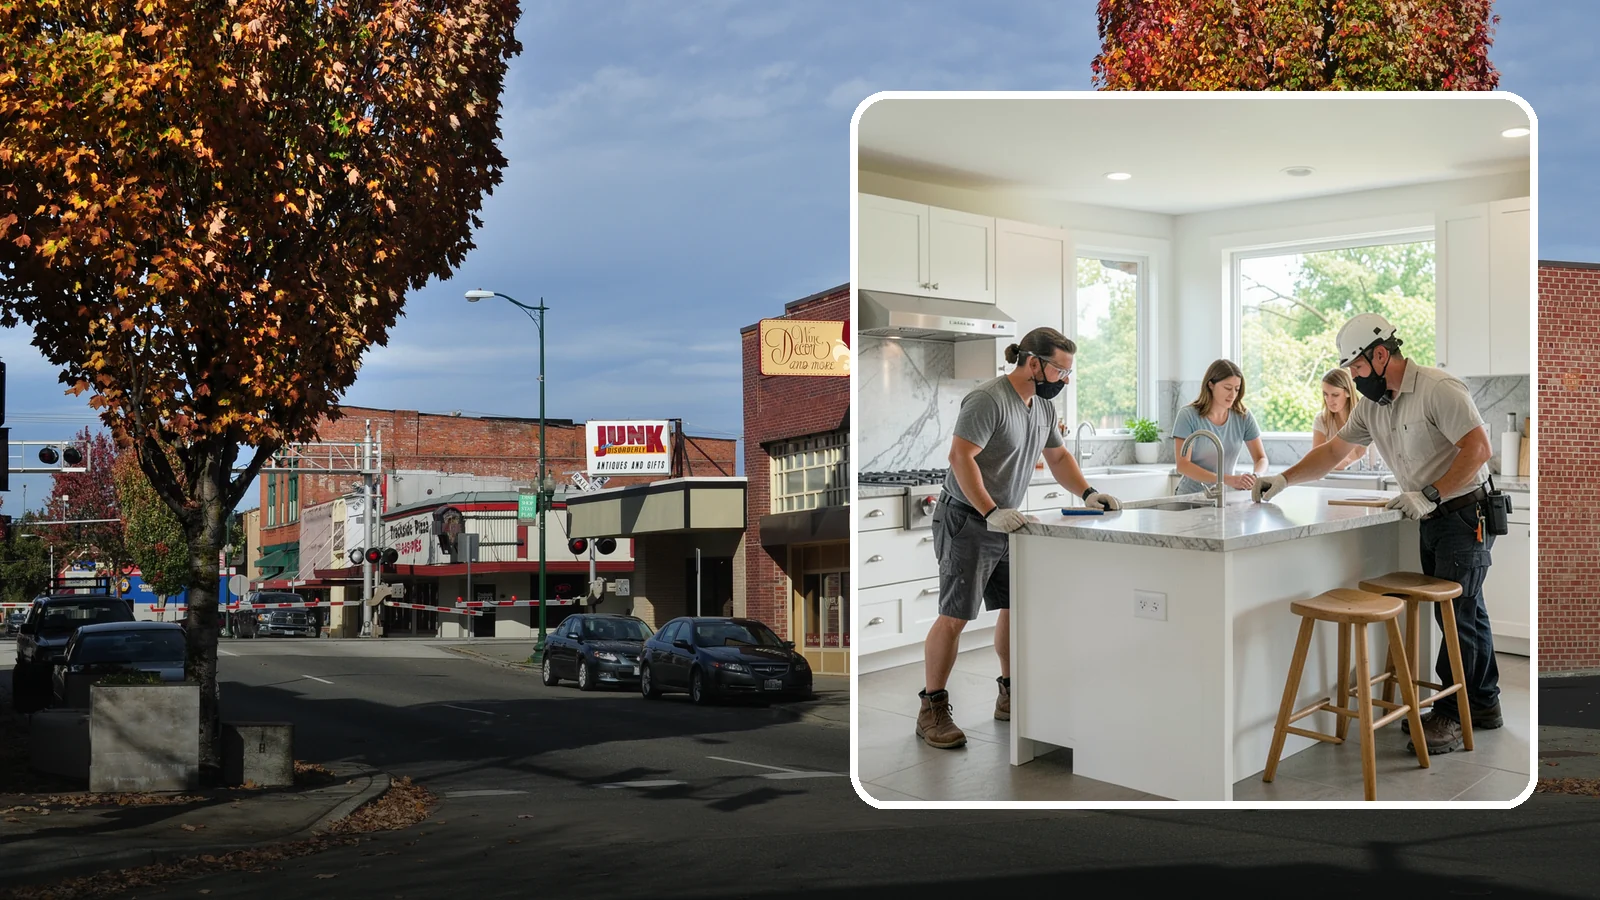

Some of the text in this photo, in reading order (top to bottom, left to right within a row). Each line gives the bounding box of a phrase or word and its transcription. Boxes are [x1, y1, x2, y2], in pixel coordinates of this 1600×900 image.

[595, 425, 665, 457] JUNK
[607, 446, 646, 454] DISORDERLY
[596, 460, 665, 470] ANTIQUES AND GIFTS
[352, 498, 365, 511] CRO
[414, 519, 429, 535] Pizza
